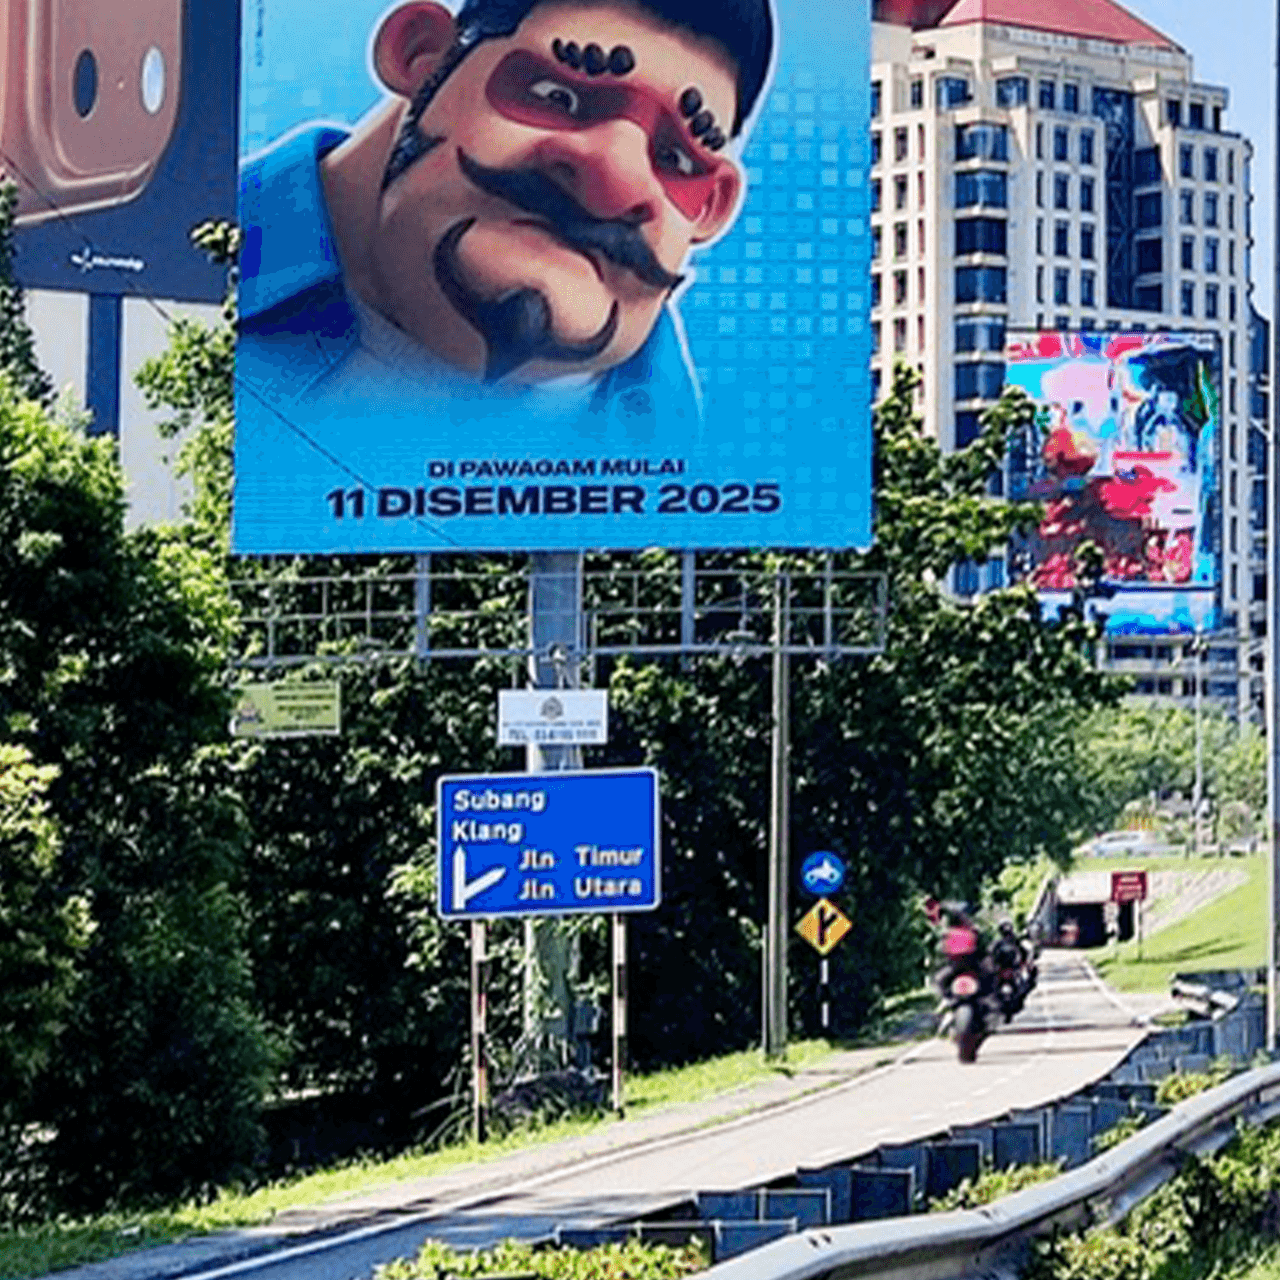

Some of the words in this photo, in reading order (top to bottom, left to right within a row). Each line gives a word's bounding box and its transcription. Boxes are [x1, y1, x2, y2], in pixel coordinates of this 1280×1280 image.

[428, 460, 453, 479] DI
[459, 459, 595, 479] PAWAGAM
[601, 458, 685, 476] MULAI
[326, 489, 365, 519] 11
[377, 486, 644, 518] DISEMBER
[657, 483, 781, 514] 2025
[454, 790, 545, 812] Subang
[453, 821, 522, 842] Klang
[519, 850, 555, 870] Jln
[576, 845, 644, 868] Timur
[519, 881, 555, 901] Jln
[575, 876, 642, 898] Utara
